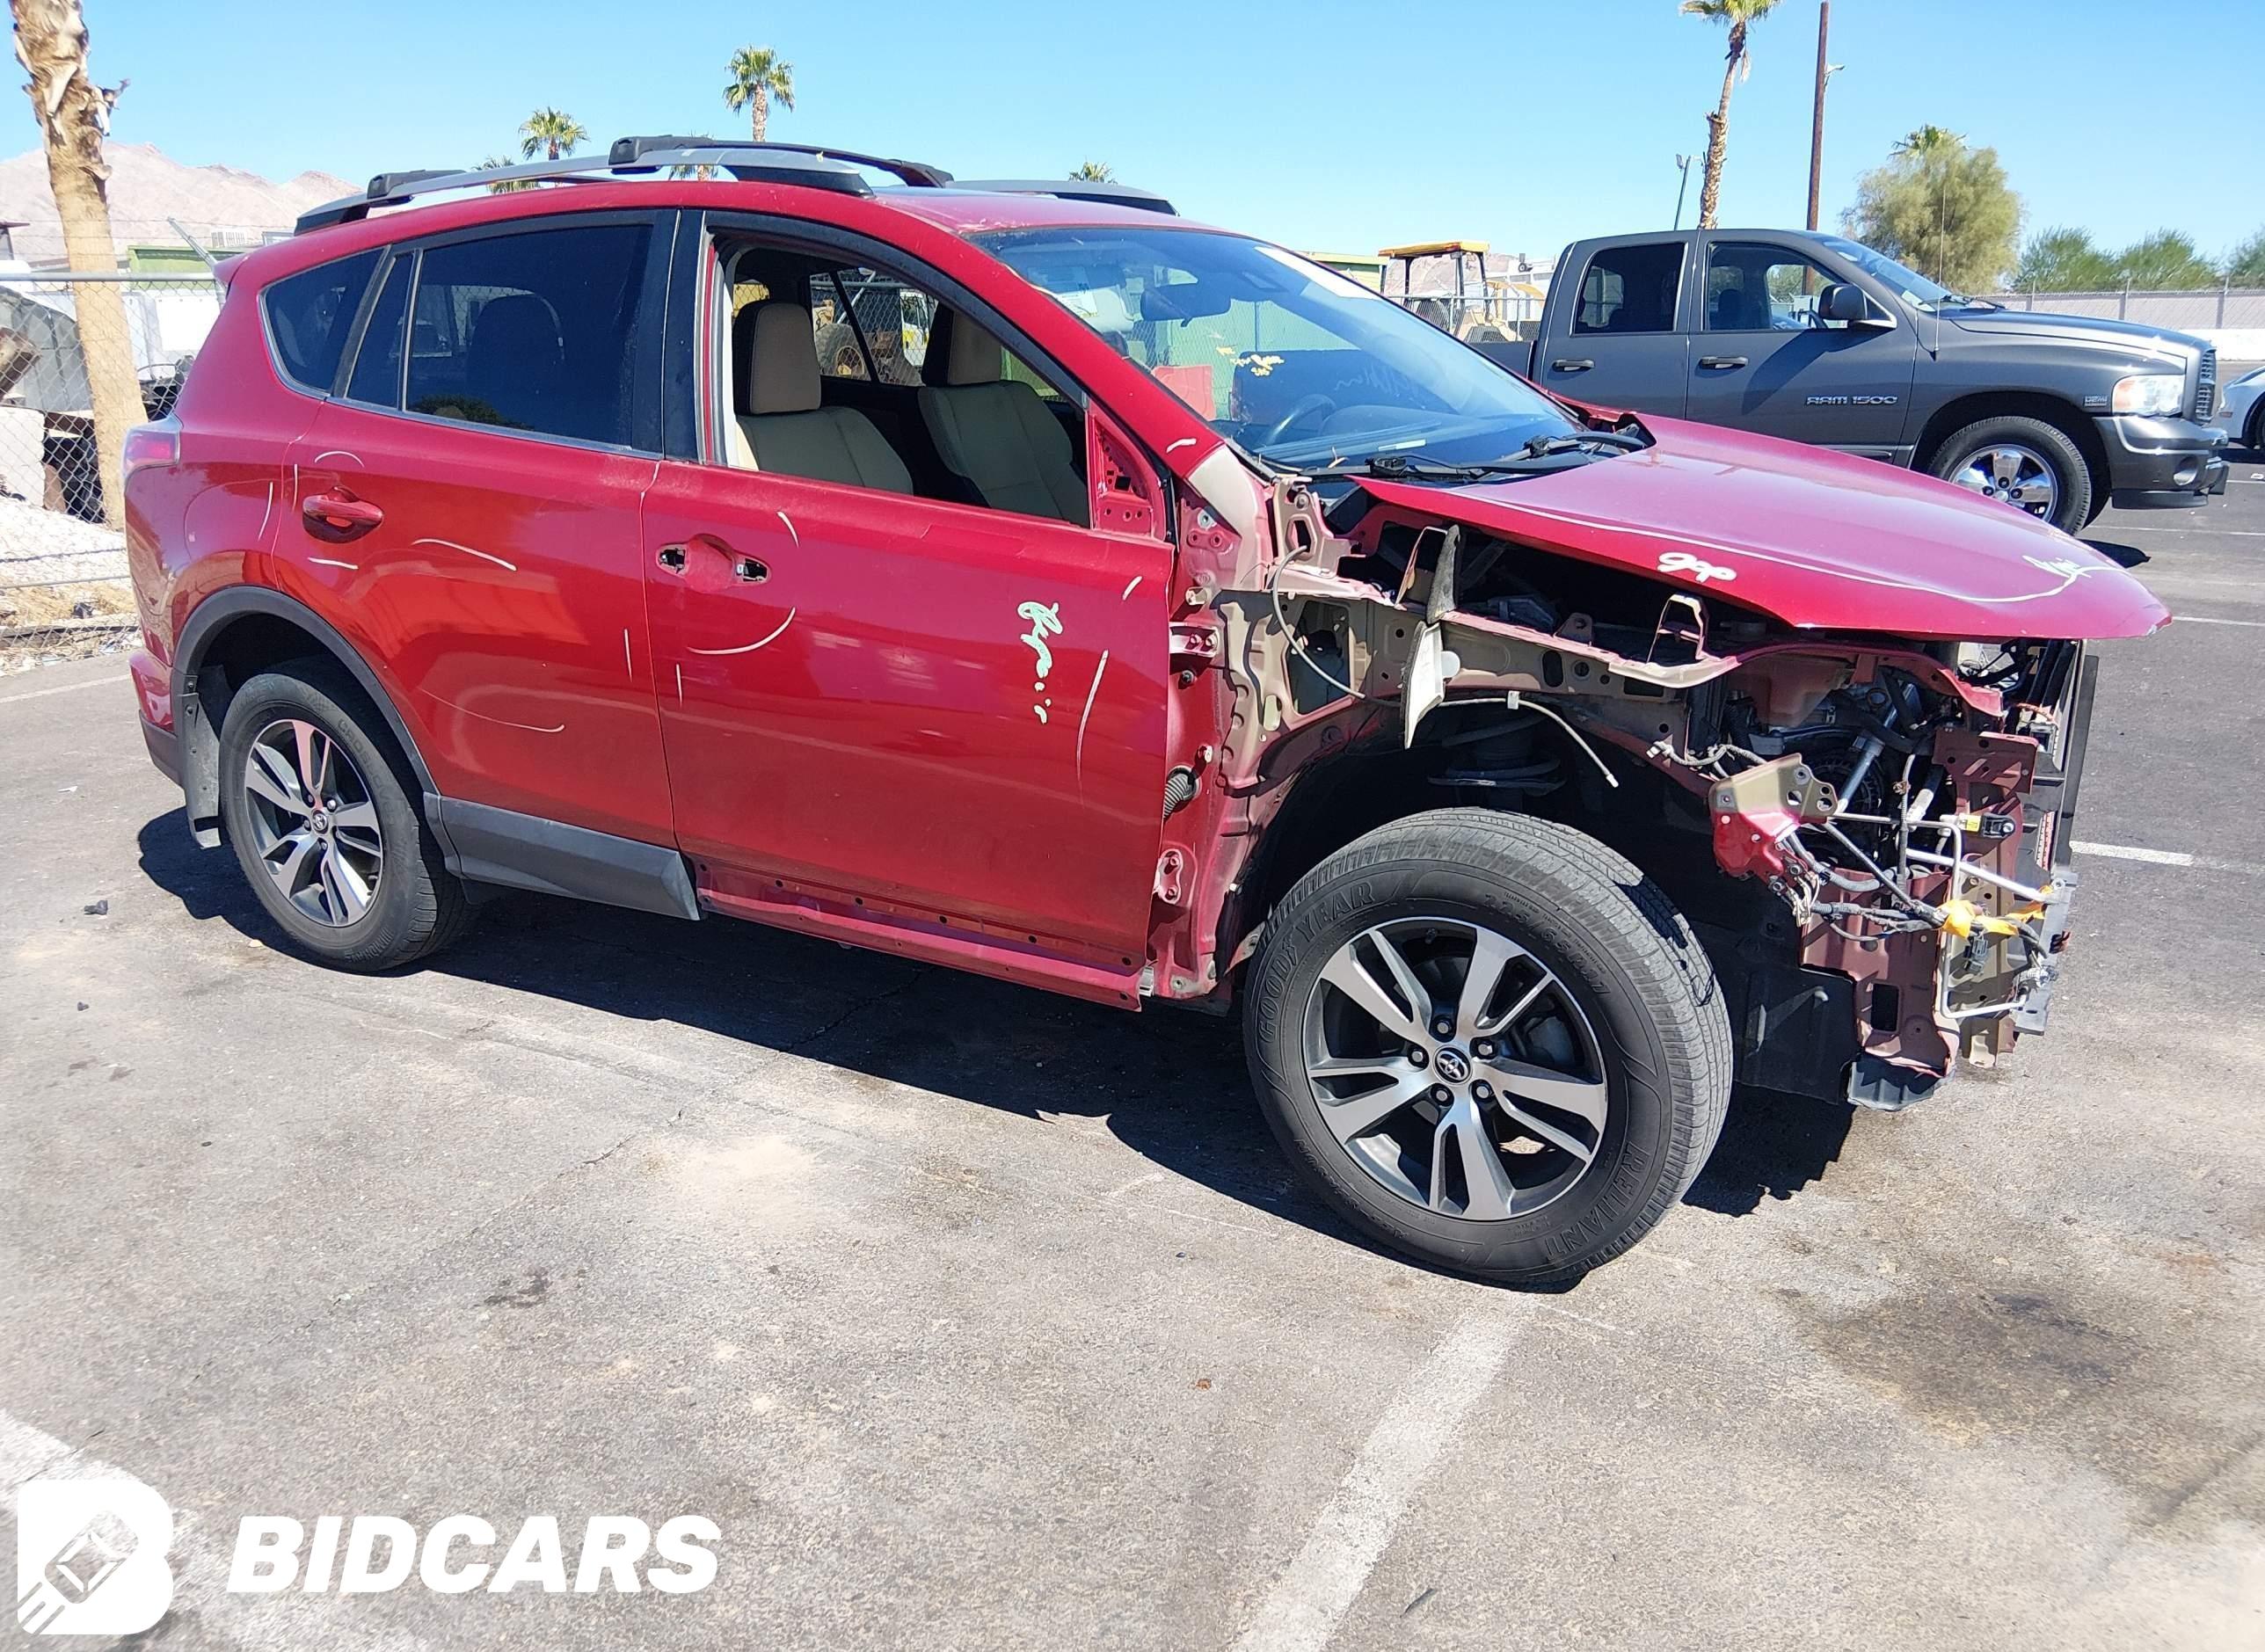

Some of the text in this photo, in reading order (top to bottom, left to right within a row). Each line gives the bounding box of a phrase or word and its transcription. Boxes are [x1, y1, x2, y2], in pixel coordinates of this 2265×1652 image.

[1805, 396, 1898, 405] RAM 1500
[1545, 1141, 1651, 1261] RELIANT
